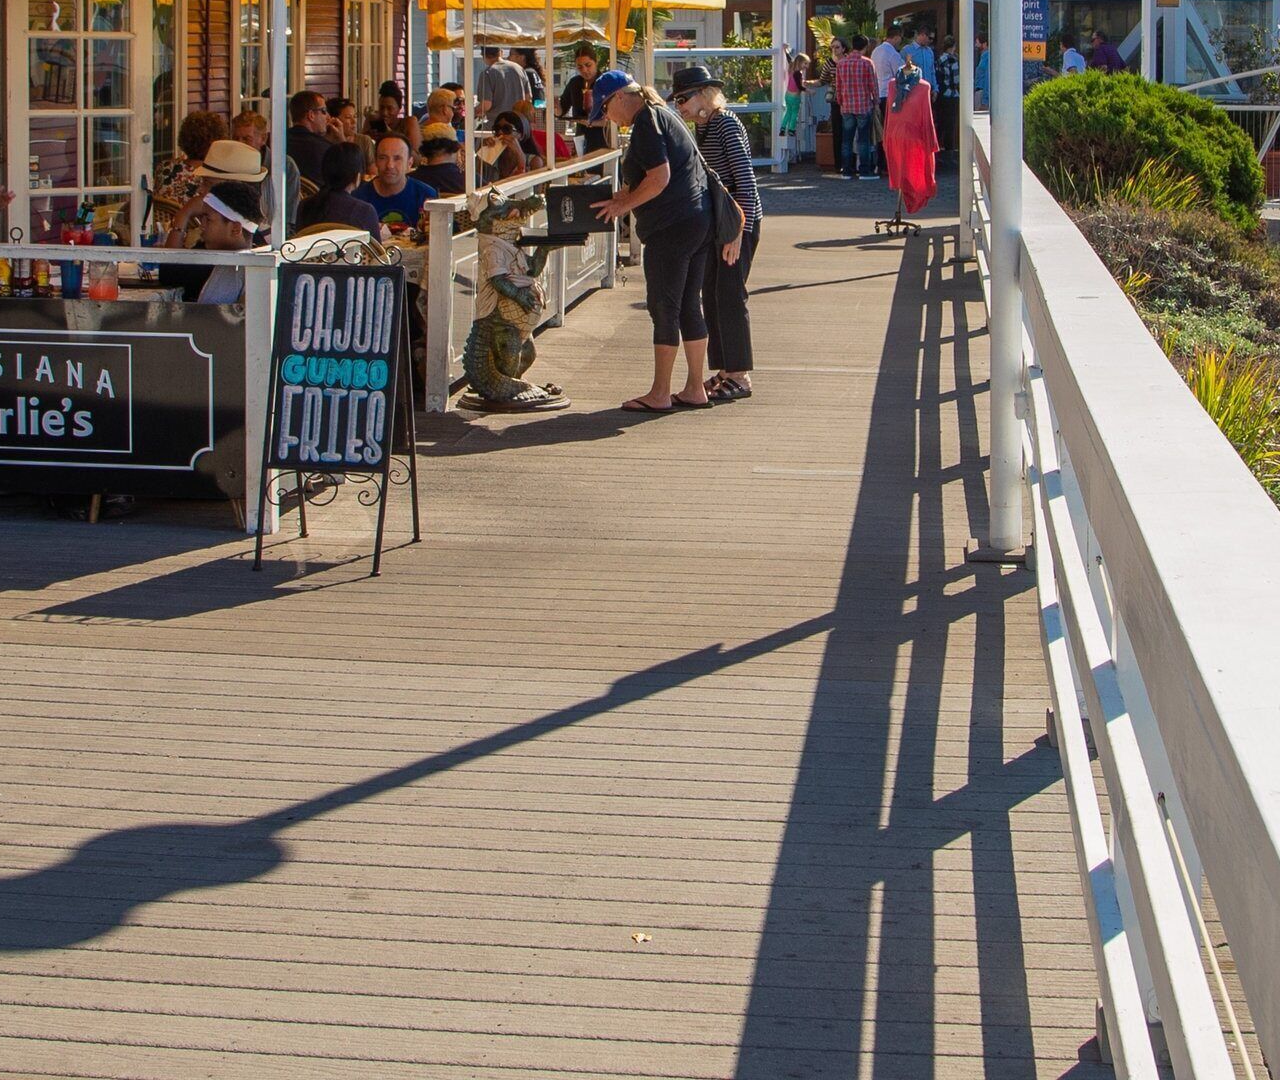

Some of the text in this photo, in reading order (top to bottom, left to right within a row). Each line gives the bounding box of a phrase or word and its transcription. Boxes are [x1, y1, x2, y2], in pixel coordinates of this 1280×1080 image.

[1022, 0, 1040, 10] pirit
[1023, 43, 1042, 54] ck 9
[292, 274, 395, 354] CAJUN
[281, 354, 388, 390] GUMBO
[278, 385, 386, 465] FRIES
